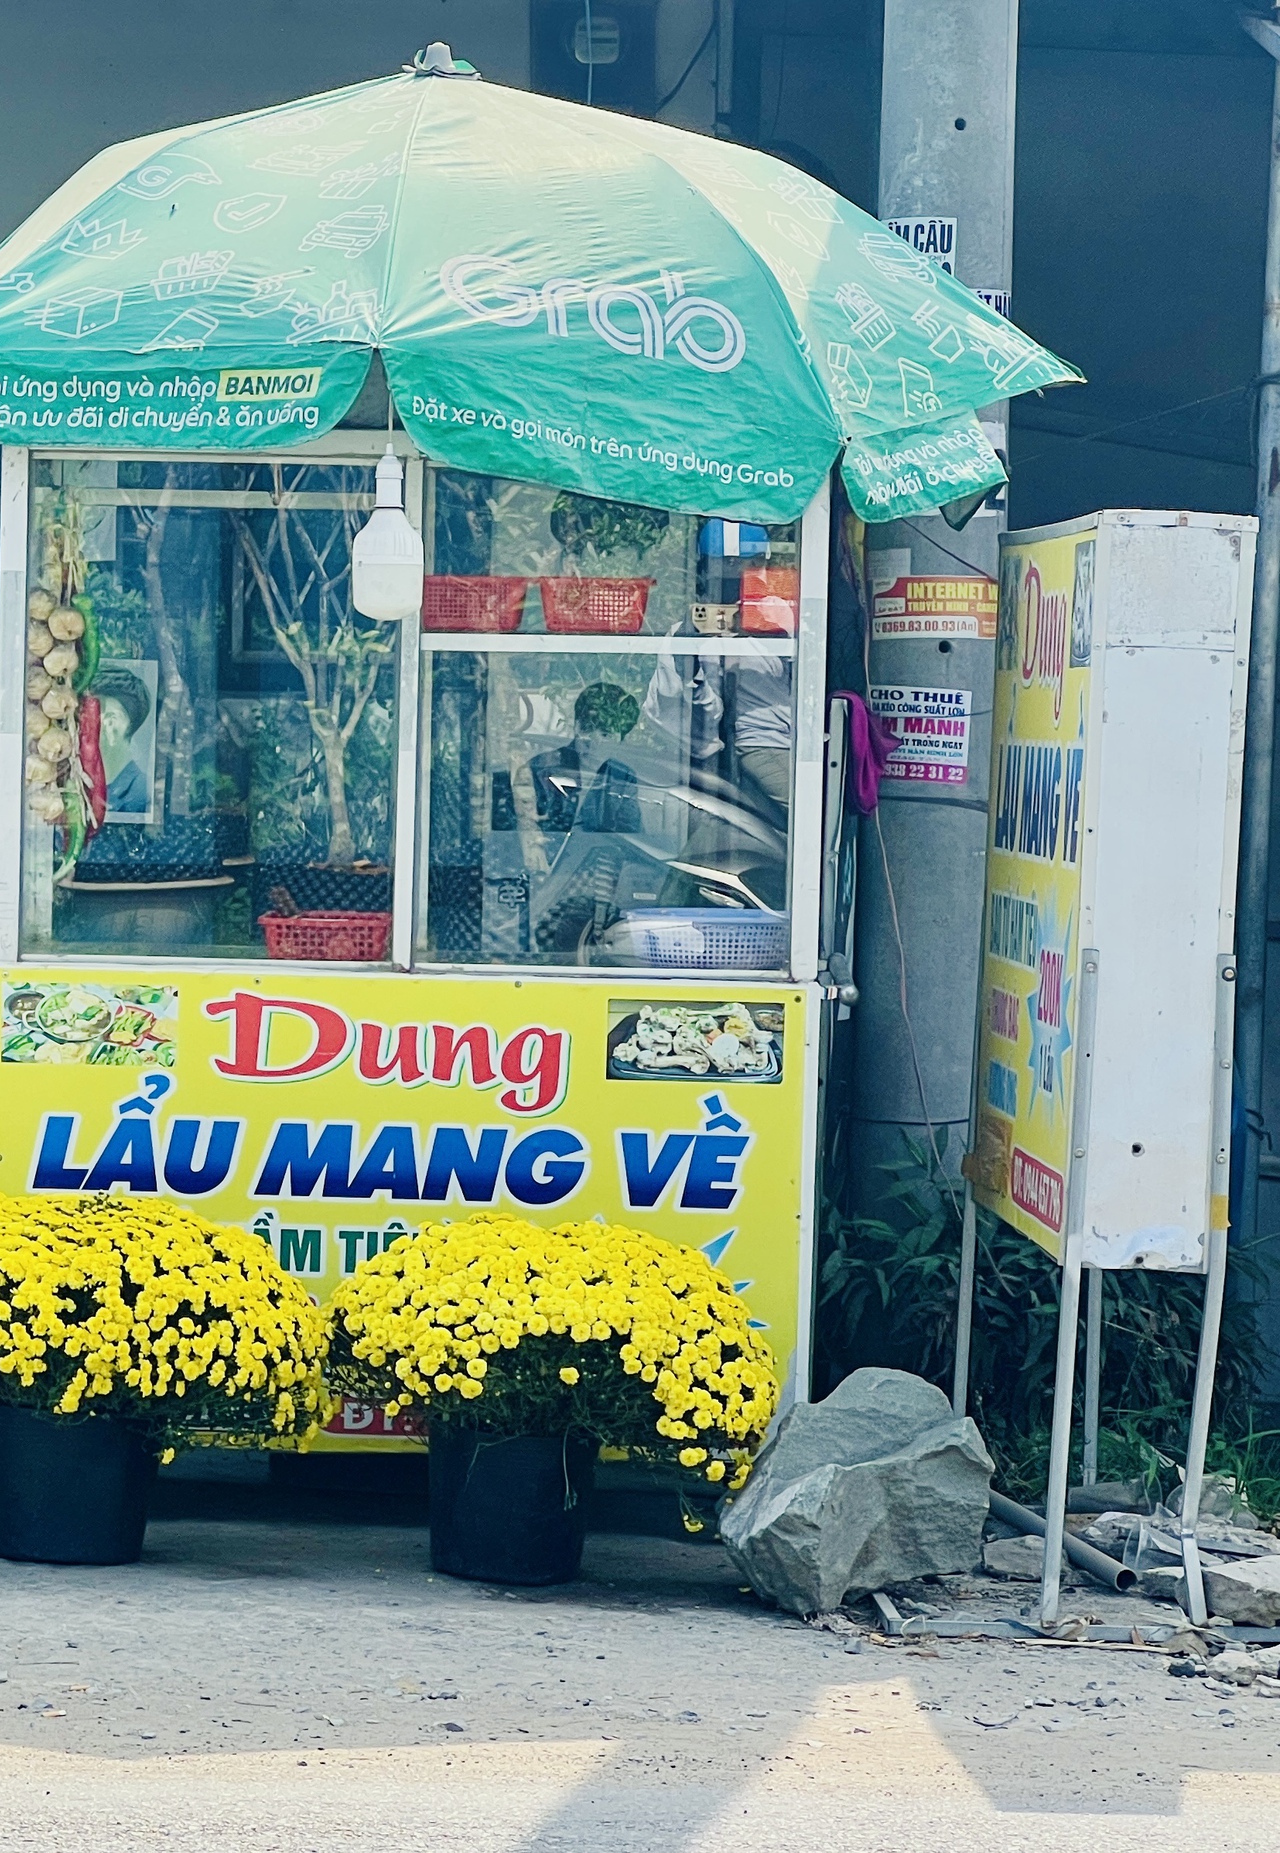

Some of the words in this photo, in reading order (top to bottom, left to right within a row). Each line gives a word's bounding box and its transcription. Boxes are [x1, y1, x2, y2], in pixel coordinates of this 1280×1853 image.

[914, 220, 953, 254] CẦU
[439, 253, 747, 374] Grab
[13, 376, 58, 402] ứng
[62, 376, 122, 403] dụng
[125, 374, 155, 396] và
[158, 376, 217, 403] nhập
[224, 374, 314, 397] BANMOI
[32, 410, 63, 429] ưu
[67, 406, 103, 428] đãi
[108, 406, 129, 428] di
[131, 402, 213, 433] chuyển
[216, 408, 231, 426] &
[235, 405, 264, 427] ăn
[266, 401, 319, 429] uống
[412, 395, 447, 423] Đặt
[451, 408, 476, 425] xe
[480, 408, 507, 431] và
[511, 413, 543, 440] gọi
[545, 426, 586, 450] món
[589, 437, 633, 460] trên
[636, 442, 679, 471] ứng
[682, 450, 734, 484] dụng
[737, 463, 795, 488] Grab
[907, 582, 984, 600] INTERNET
[871, 689, 904, 701] CHO
[911, 690, 964, 704] THUÊ
[898, 702, 922, 714] CÔNG
[924, 703, 946, 715] SUẤT
[903, 716, 965, 738] MẠNH
[884, 762, 906, 777] 938
[908, 764, 925, 778] 22
[928, 766, 944, 780] 31
[947, 767, 964, 781] 22
[1019, 746, 1062, 861] MANG
[204, 992, 566, 1113] Dung
[34, 1073, 243, 1193] LẨU
[255, 1123, 588, 1204] MANG
[620, 1094, 751, 1210] VỀ
